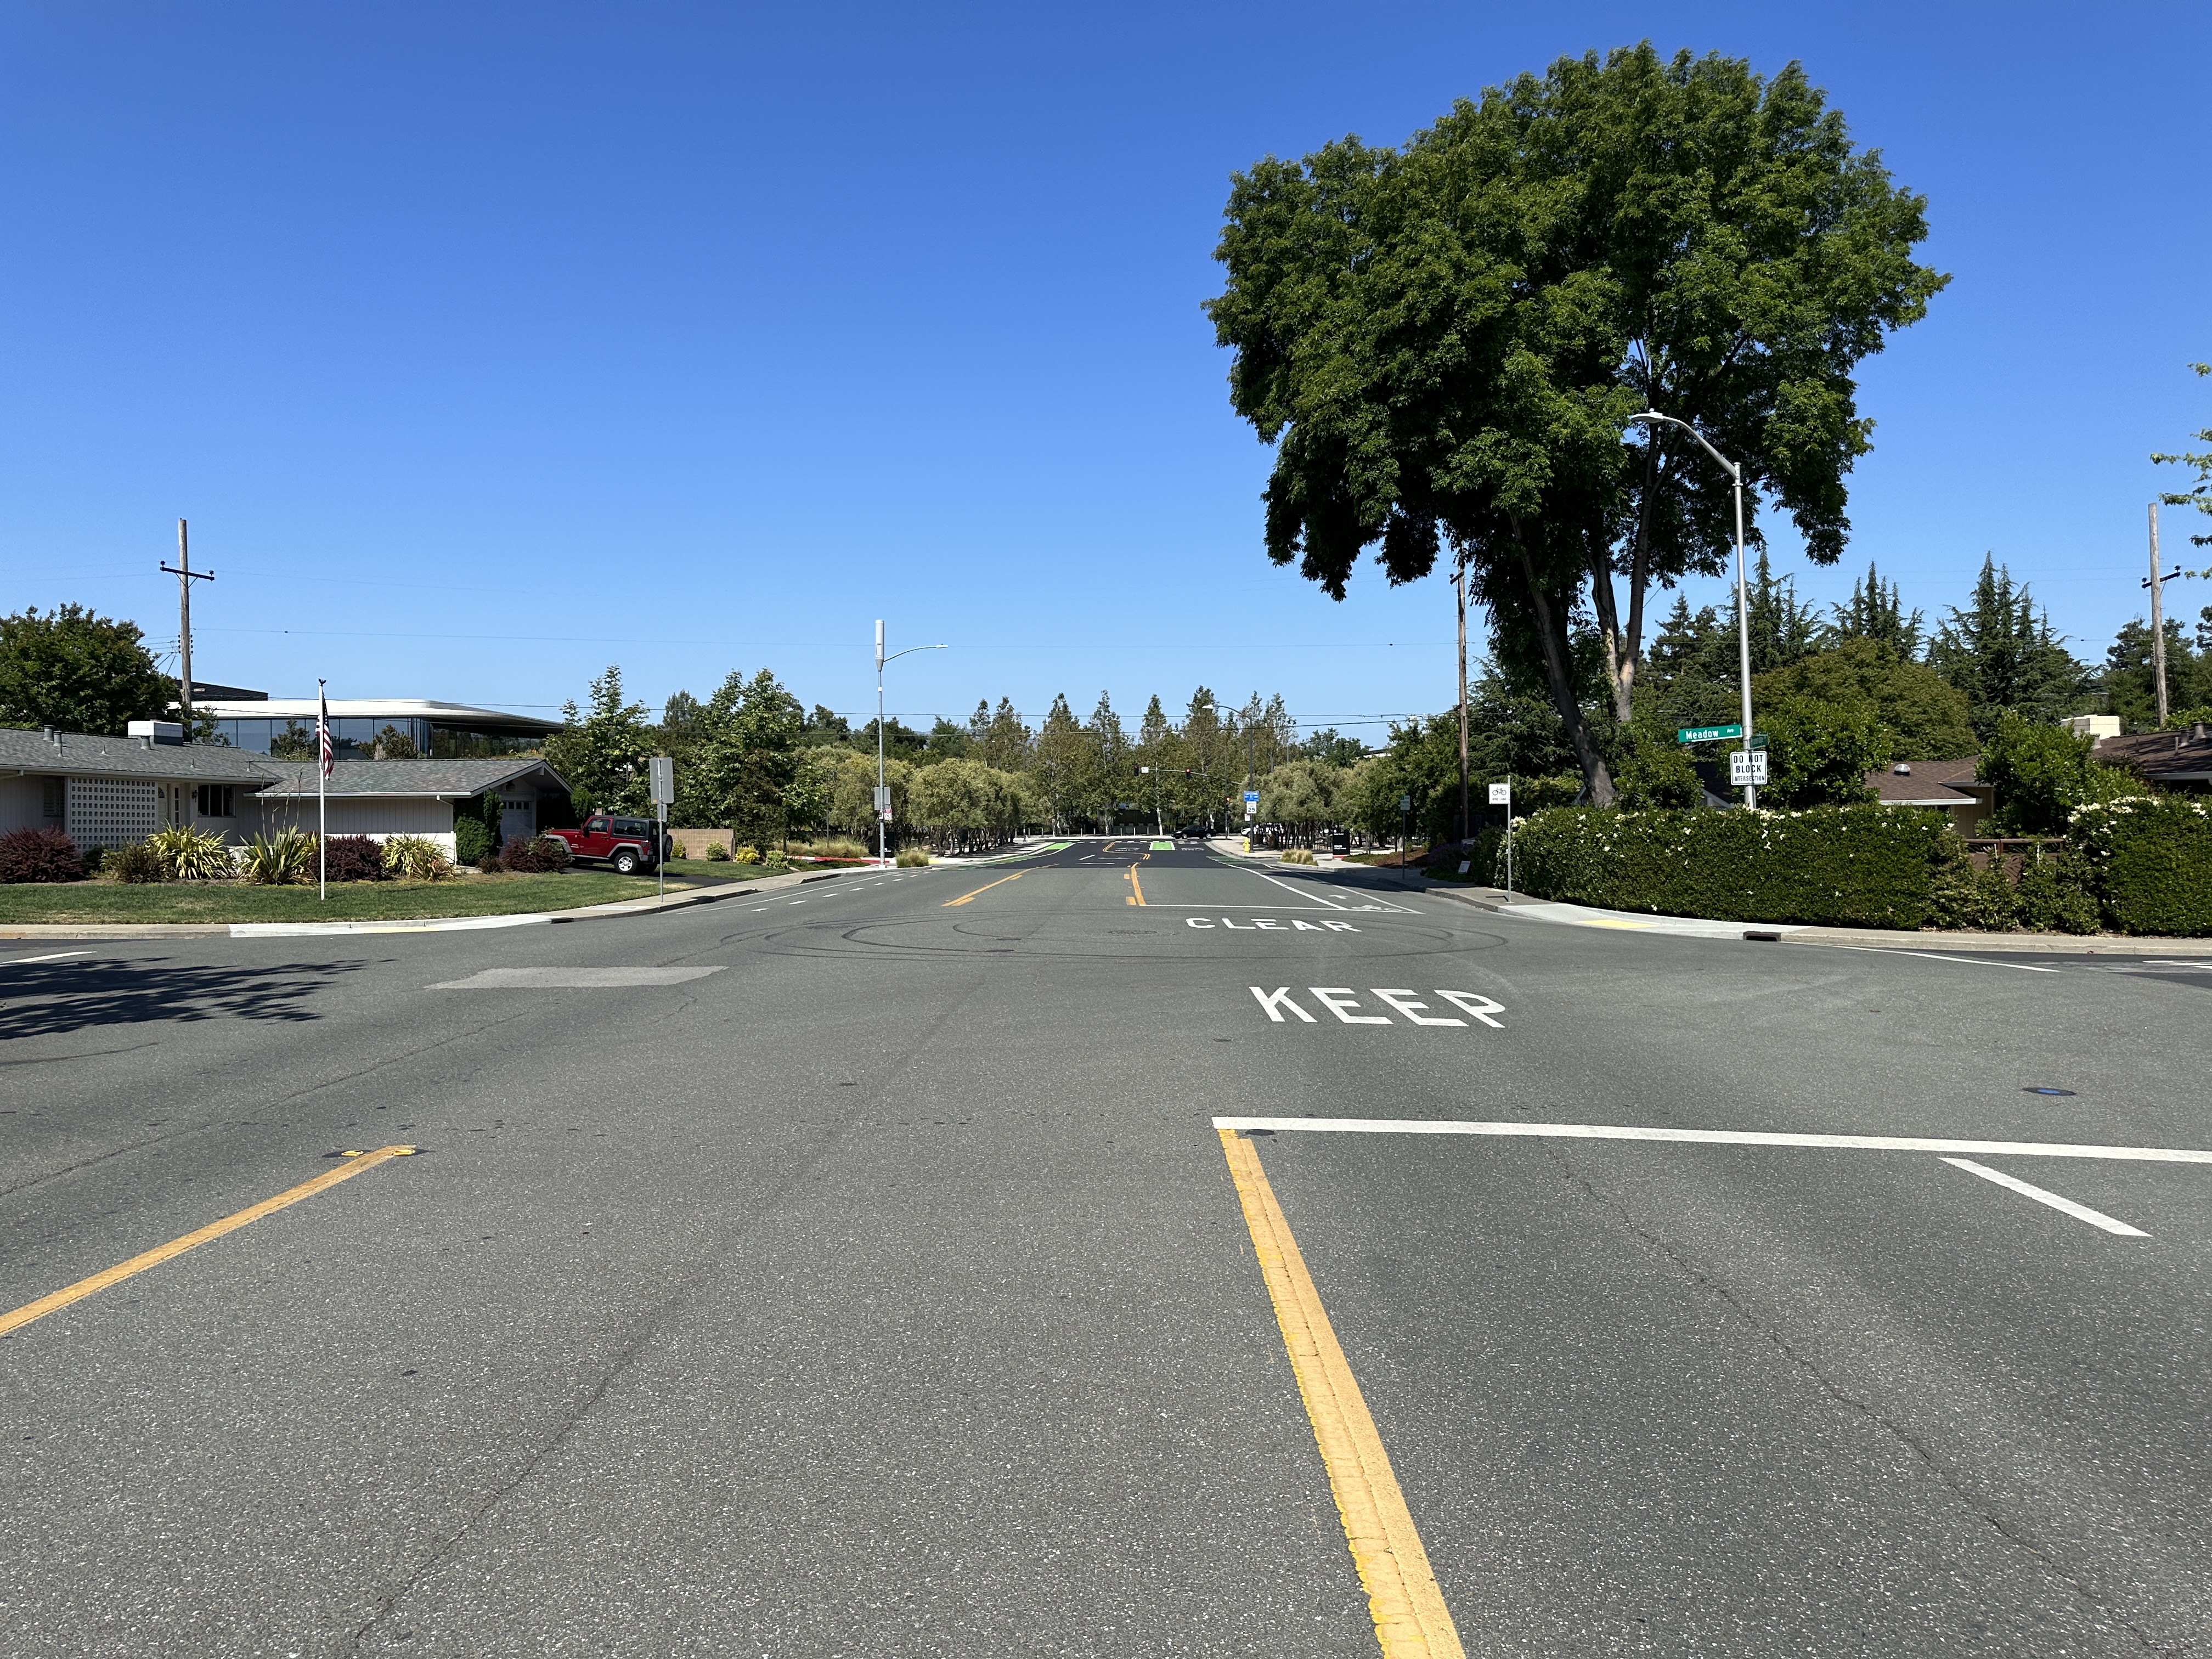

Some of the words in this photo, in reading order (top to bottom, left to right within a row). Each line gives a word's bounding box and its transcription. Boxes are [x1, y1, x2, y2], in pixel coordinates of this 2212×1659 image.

[1685, 729, 1719, 740] Meadow
[1734, 755, 1743, 763] DO
[1748, 754, 1763, 763] NOT
[1736, 764, 1762, 773] BLOCK
[1186, 917, 1362, 932] CLEAR
[1249, 986, 1505, 1028] KEEP
